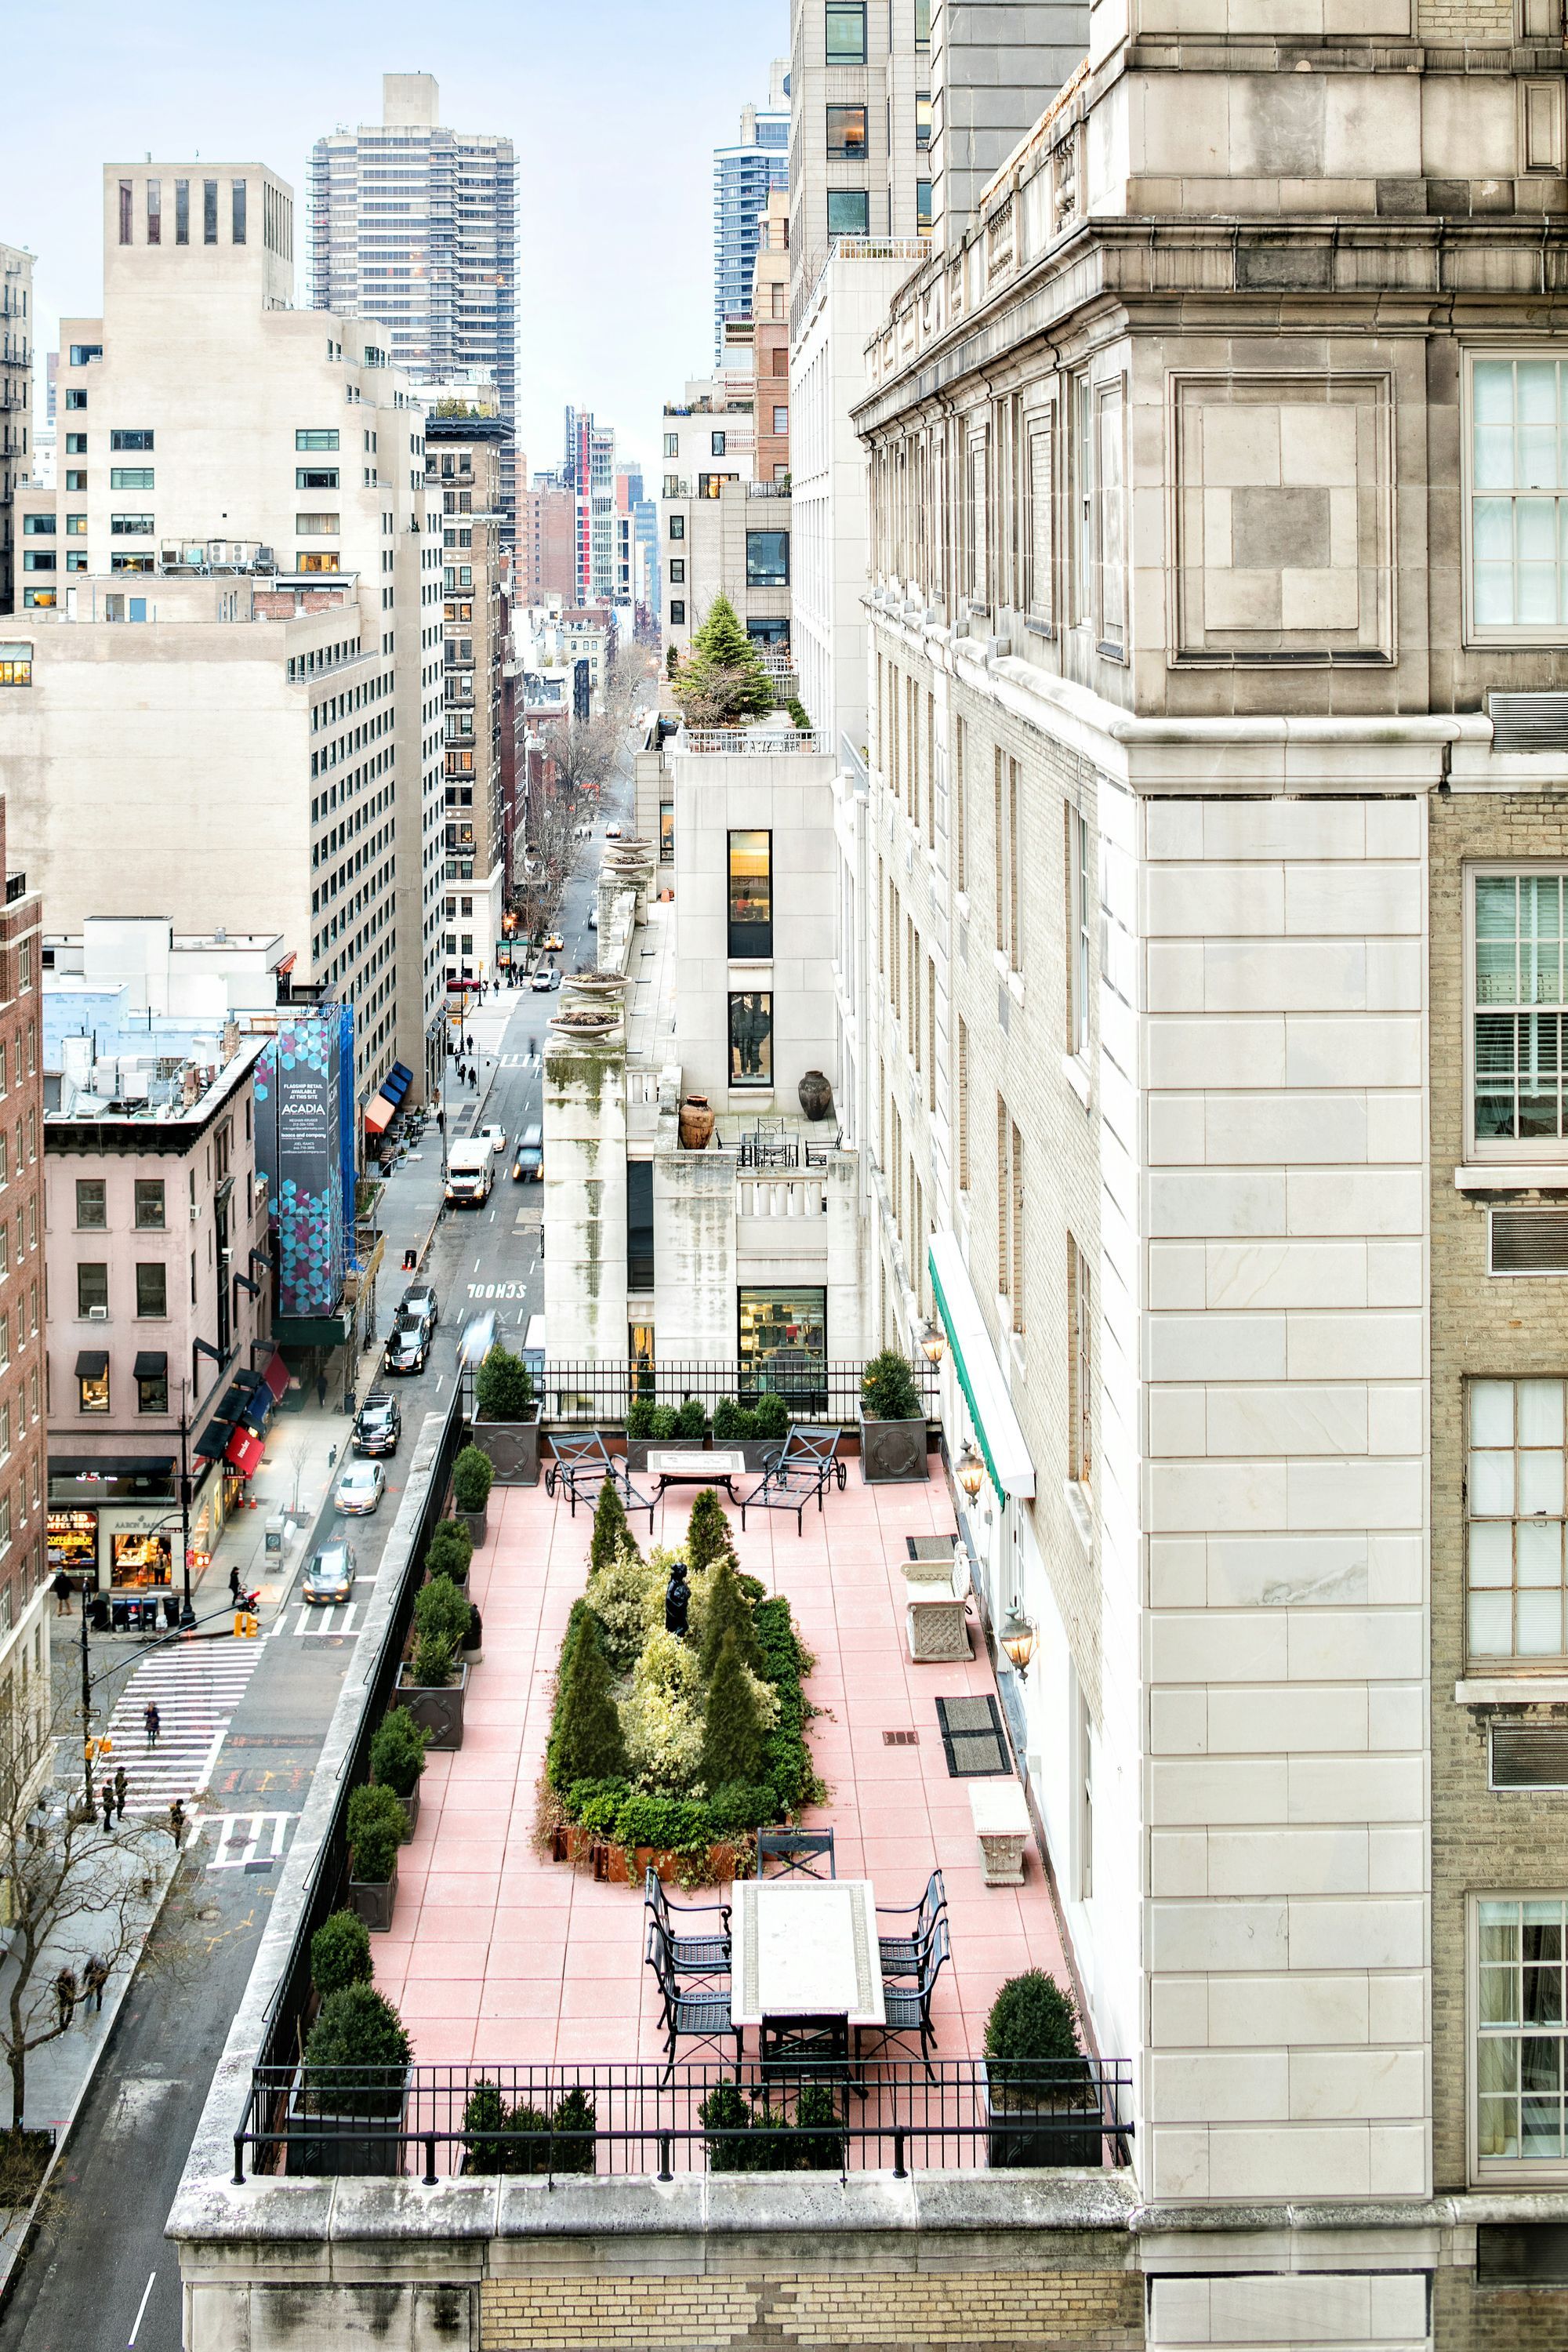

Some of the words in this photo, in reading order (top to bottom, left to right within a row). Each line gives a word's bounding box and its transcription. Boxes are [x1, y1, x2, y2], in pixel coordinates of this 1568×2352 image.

[281, 1104, 325, 1115] ACADIA
[466, 1283, 527, 1298] SCHOOL
[47, 1514, 89, 1523] VIAND
[73, 1536, 93, 1544] SHOP
